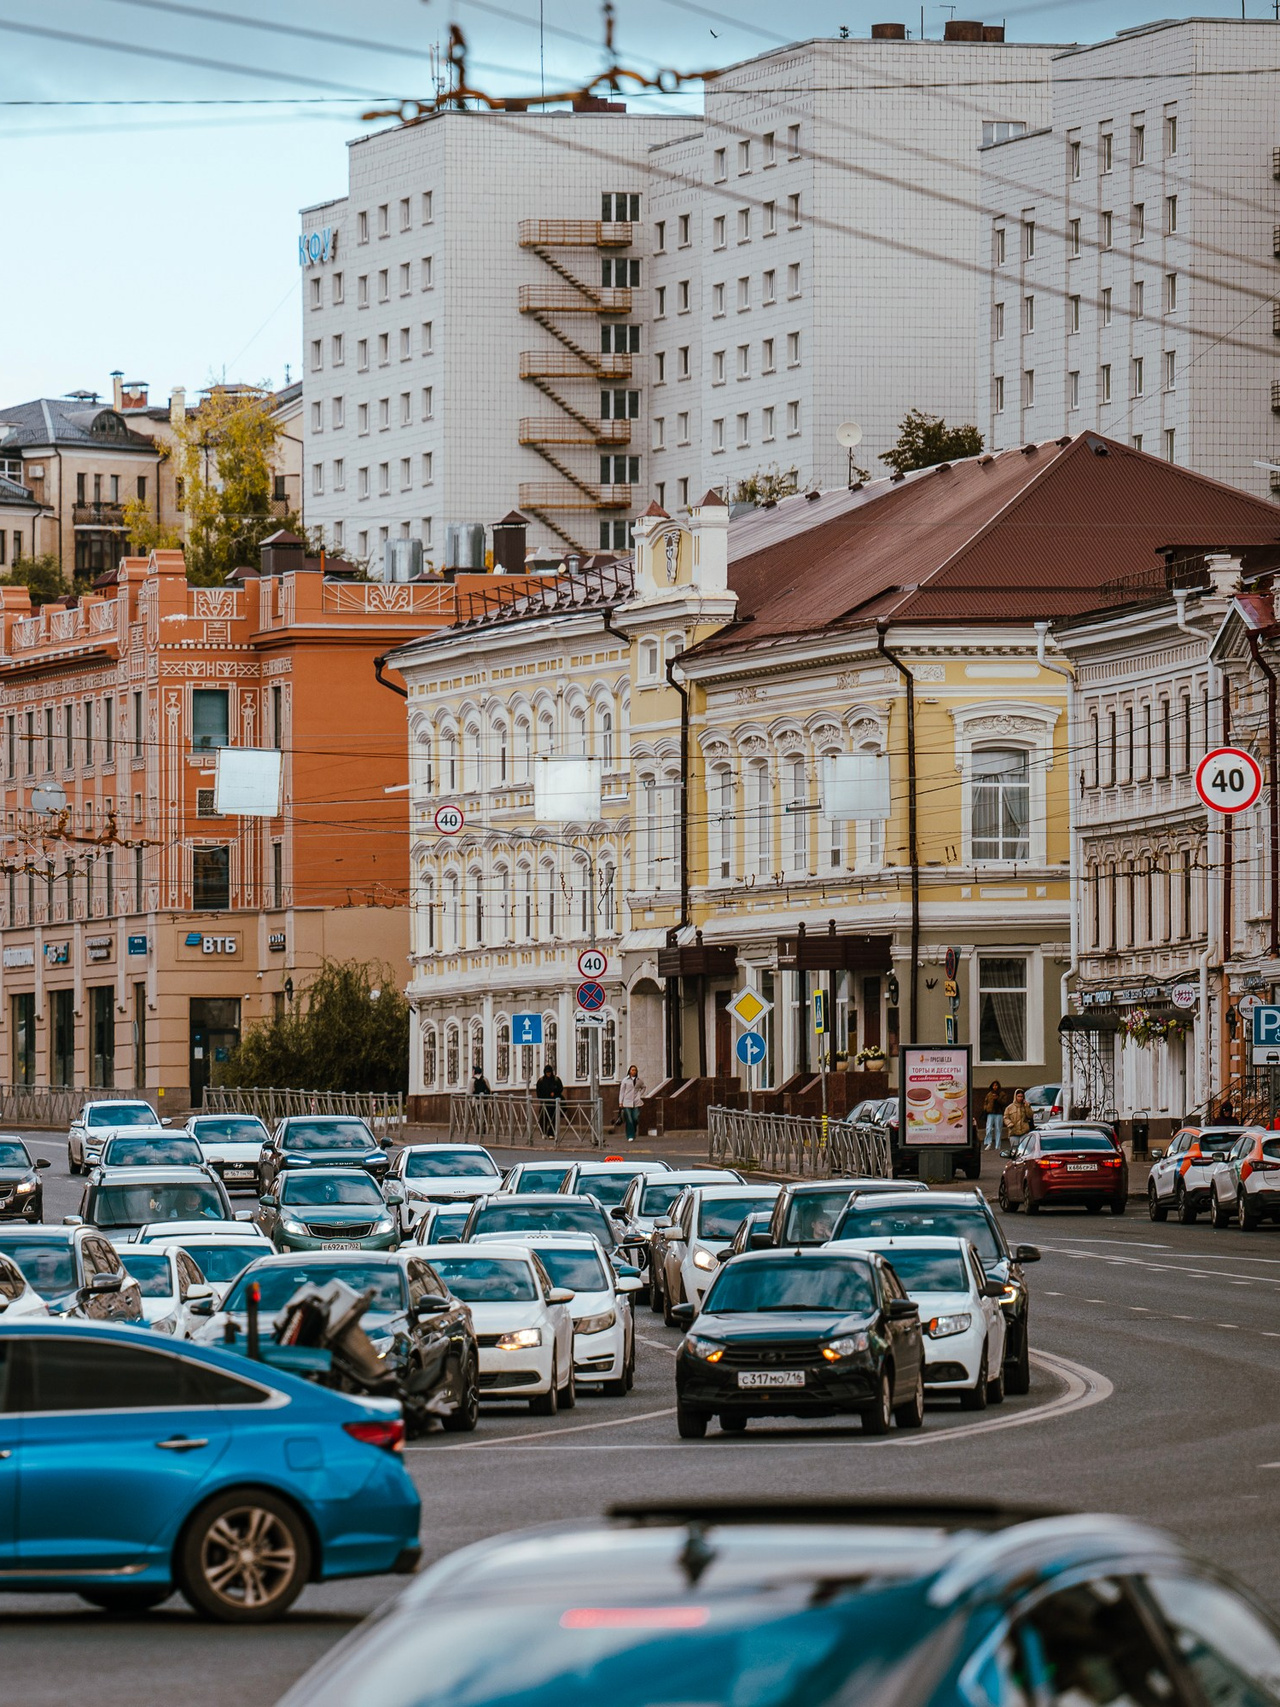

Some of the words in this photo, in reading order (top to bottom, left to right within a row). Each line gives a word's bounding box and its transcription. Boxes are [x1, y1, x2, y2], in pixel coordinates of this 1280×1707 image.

[299, 226, 332, 266] КФУ
[1212, 768, 1245, 793] 40
[440, 814, 458, 827] 40
[202, 936, 237, 954] ВТБ
[584, 958, 602, 971] 40
[1260, 1009, 1280, 1041] P
